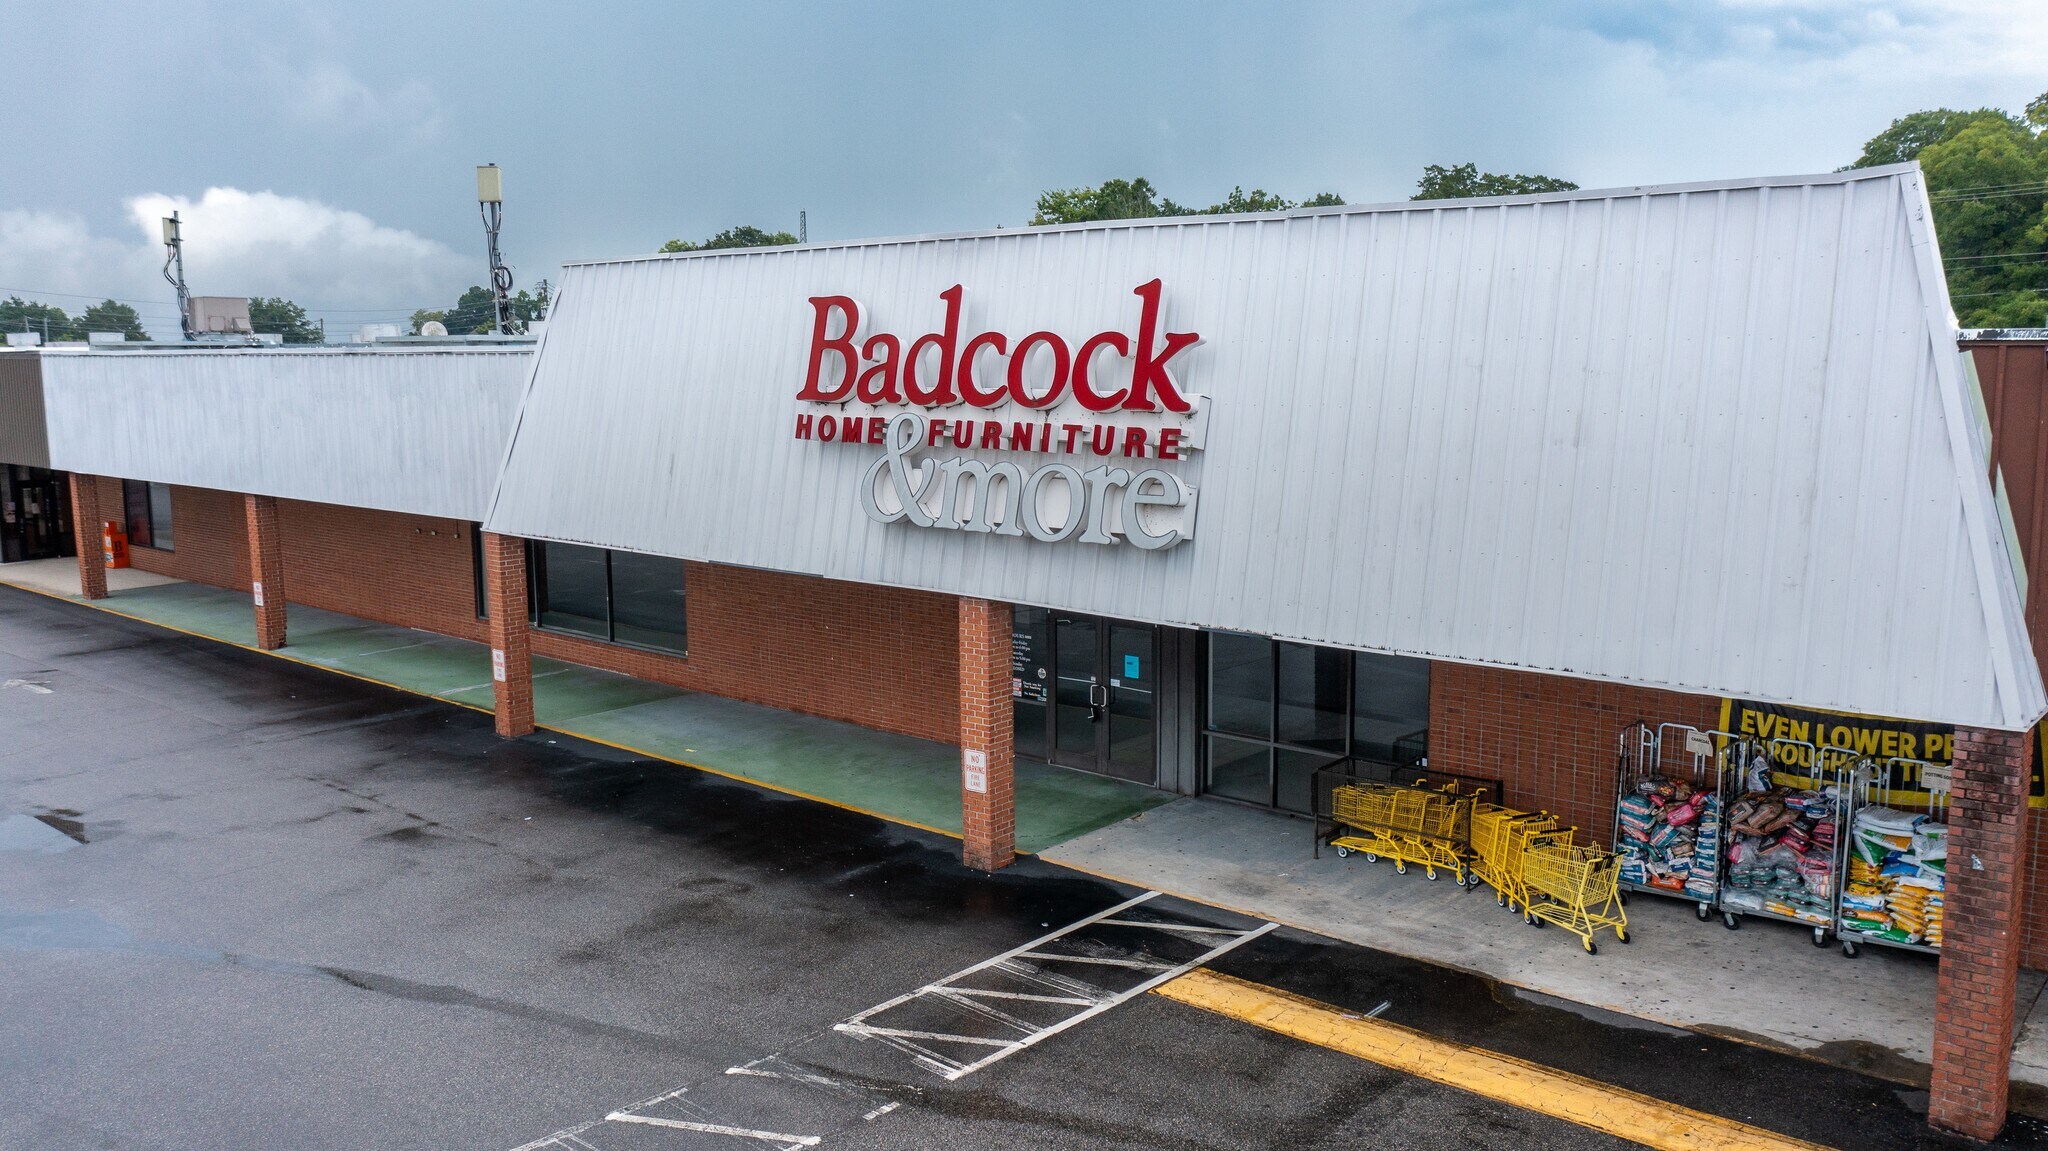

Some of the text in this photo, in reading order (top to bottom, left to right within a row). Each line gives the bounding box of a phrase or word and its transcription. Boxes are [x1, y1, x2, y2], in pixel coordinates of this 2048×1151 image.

[796, 277, 1203, 414] Badcock
[795, 413, 1184, 461] HOME FURNITURE
[1740, 707, 1810, 743] EVEN
[1815, 723, 1917, 760] LOWER
[970, 755, 980, 764] NO
